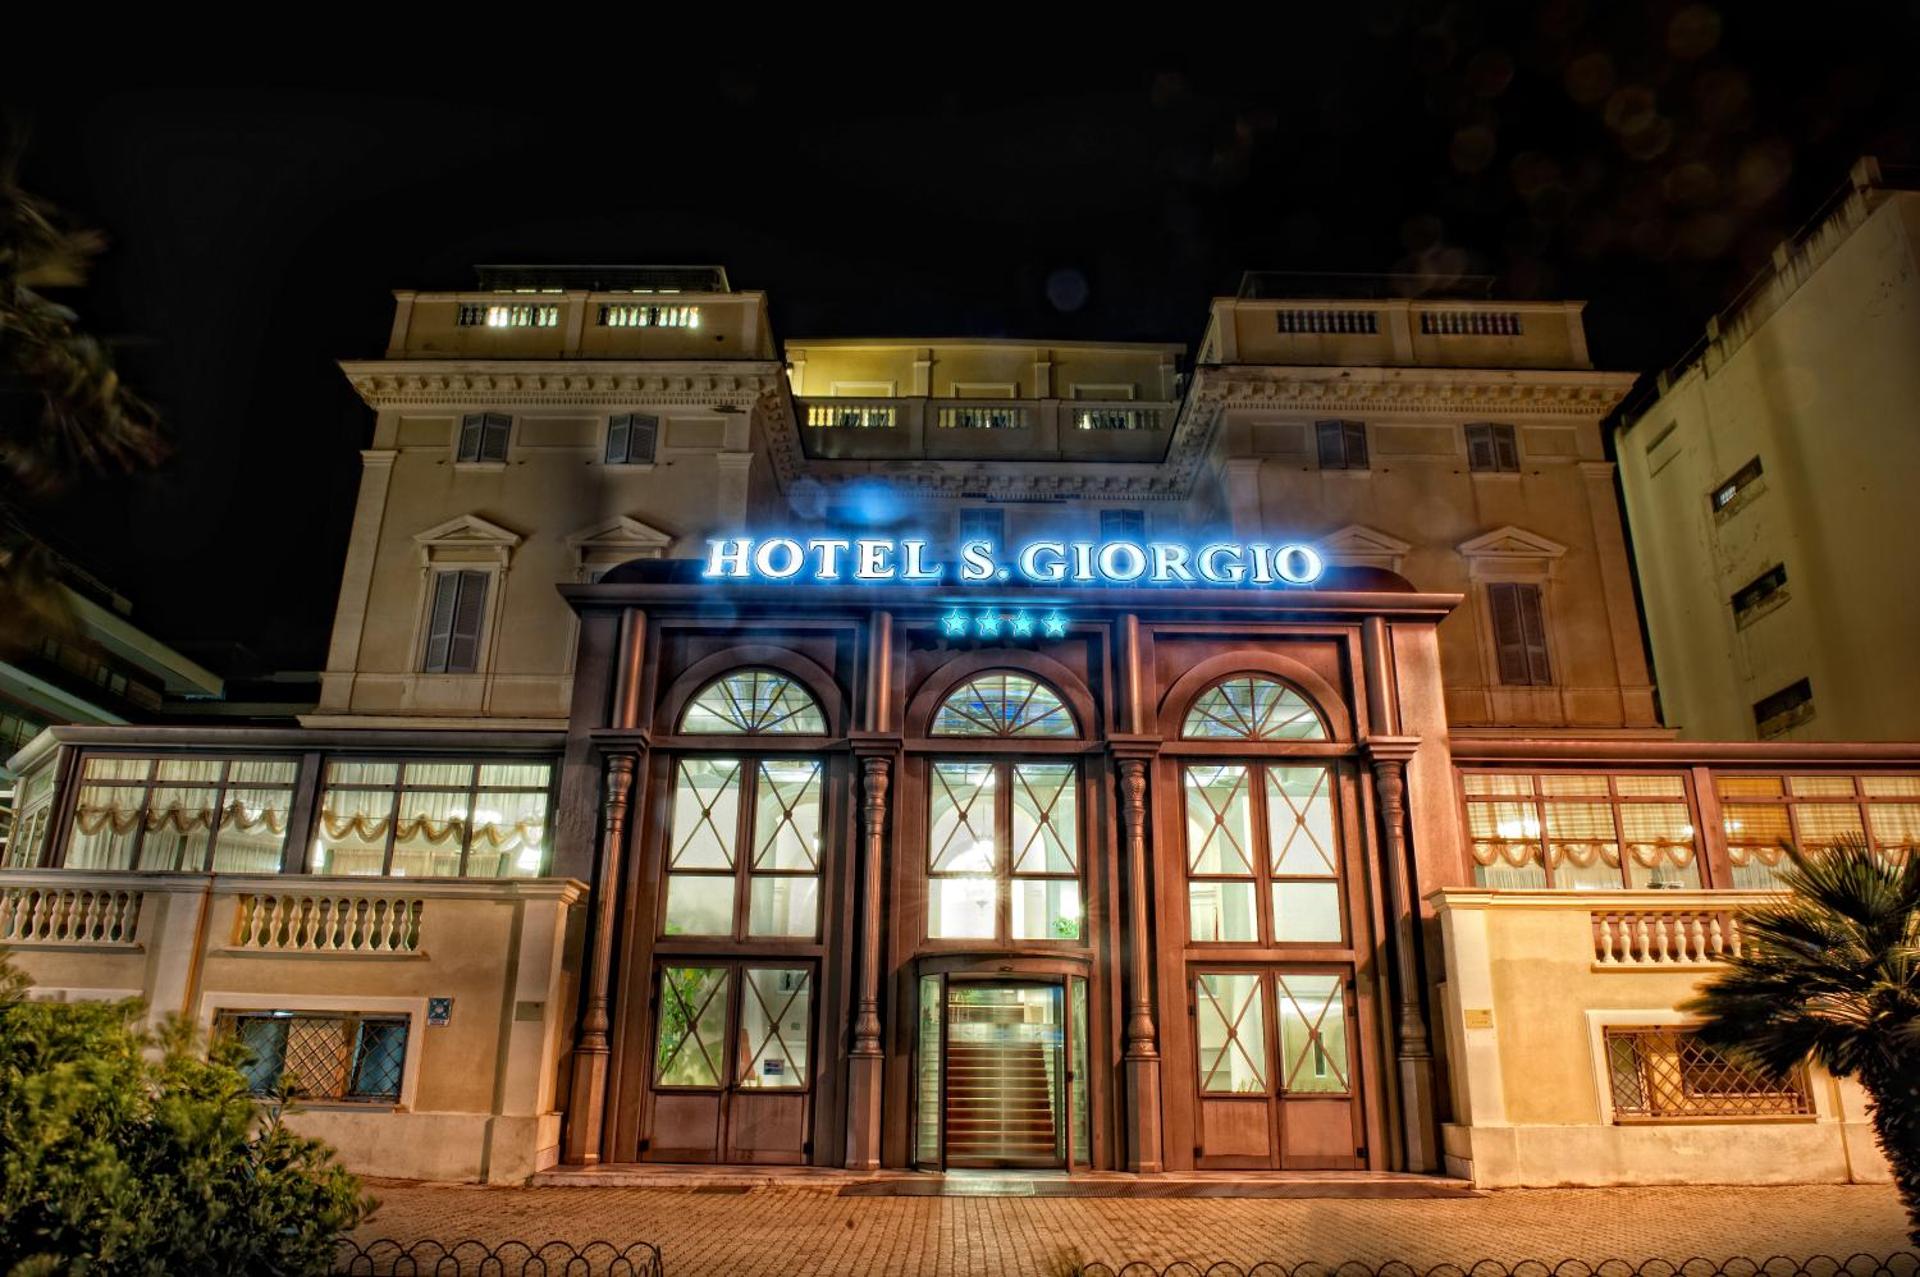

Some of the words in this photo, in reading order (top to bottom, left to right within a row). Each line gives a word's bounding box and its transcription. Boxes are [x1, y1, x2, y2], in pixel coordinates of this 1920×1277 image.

[703, 538, 943, 578] HOTEL
[962, 540, 1009, 580] S.
[1019, 541, 1323, 583] GIORGIO
